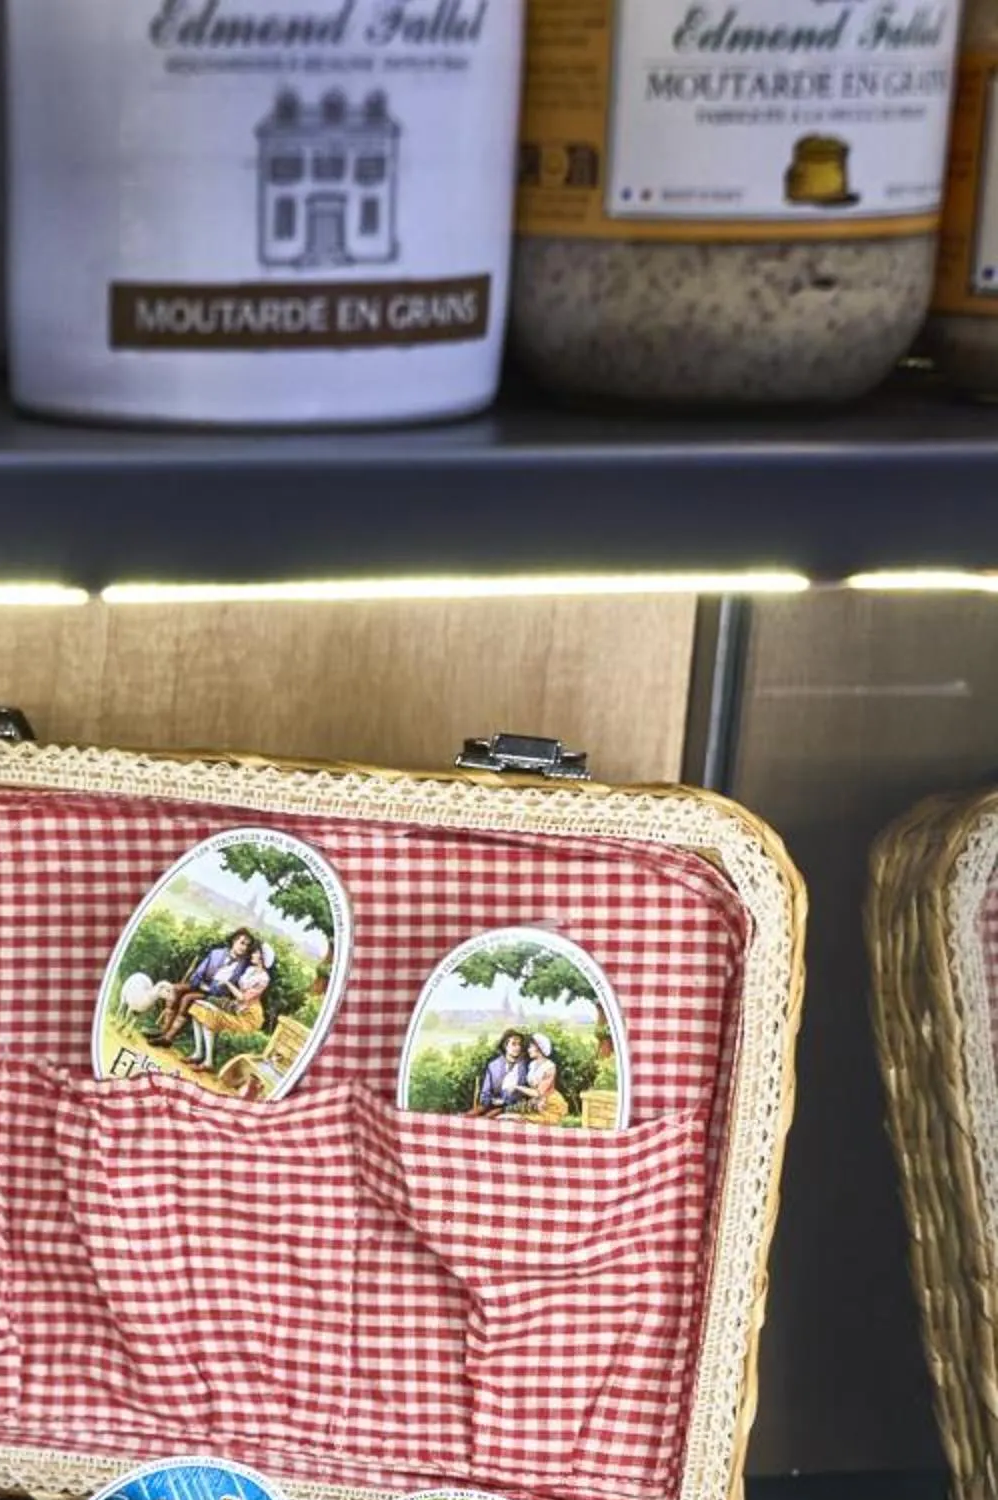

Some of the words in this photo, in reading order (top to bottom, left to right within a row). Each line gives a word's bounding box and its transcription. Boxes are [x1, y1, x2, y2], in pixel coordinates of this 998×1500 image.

[673, 3, 853, 54] Edmond
[645, 70, 832, 100] MOUTARDE
[842, 69, 879, 98] EN
[135, 297, 328, 333] MOUTARDE
[337, 297, 380, 330] EN
[386, 289, 478, 329] GRAINS
